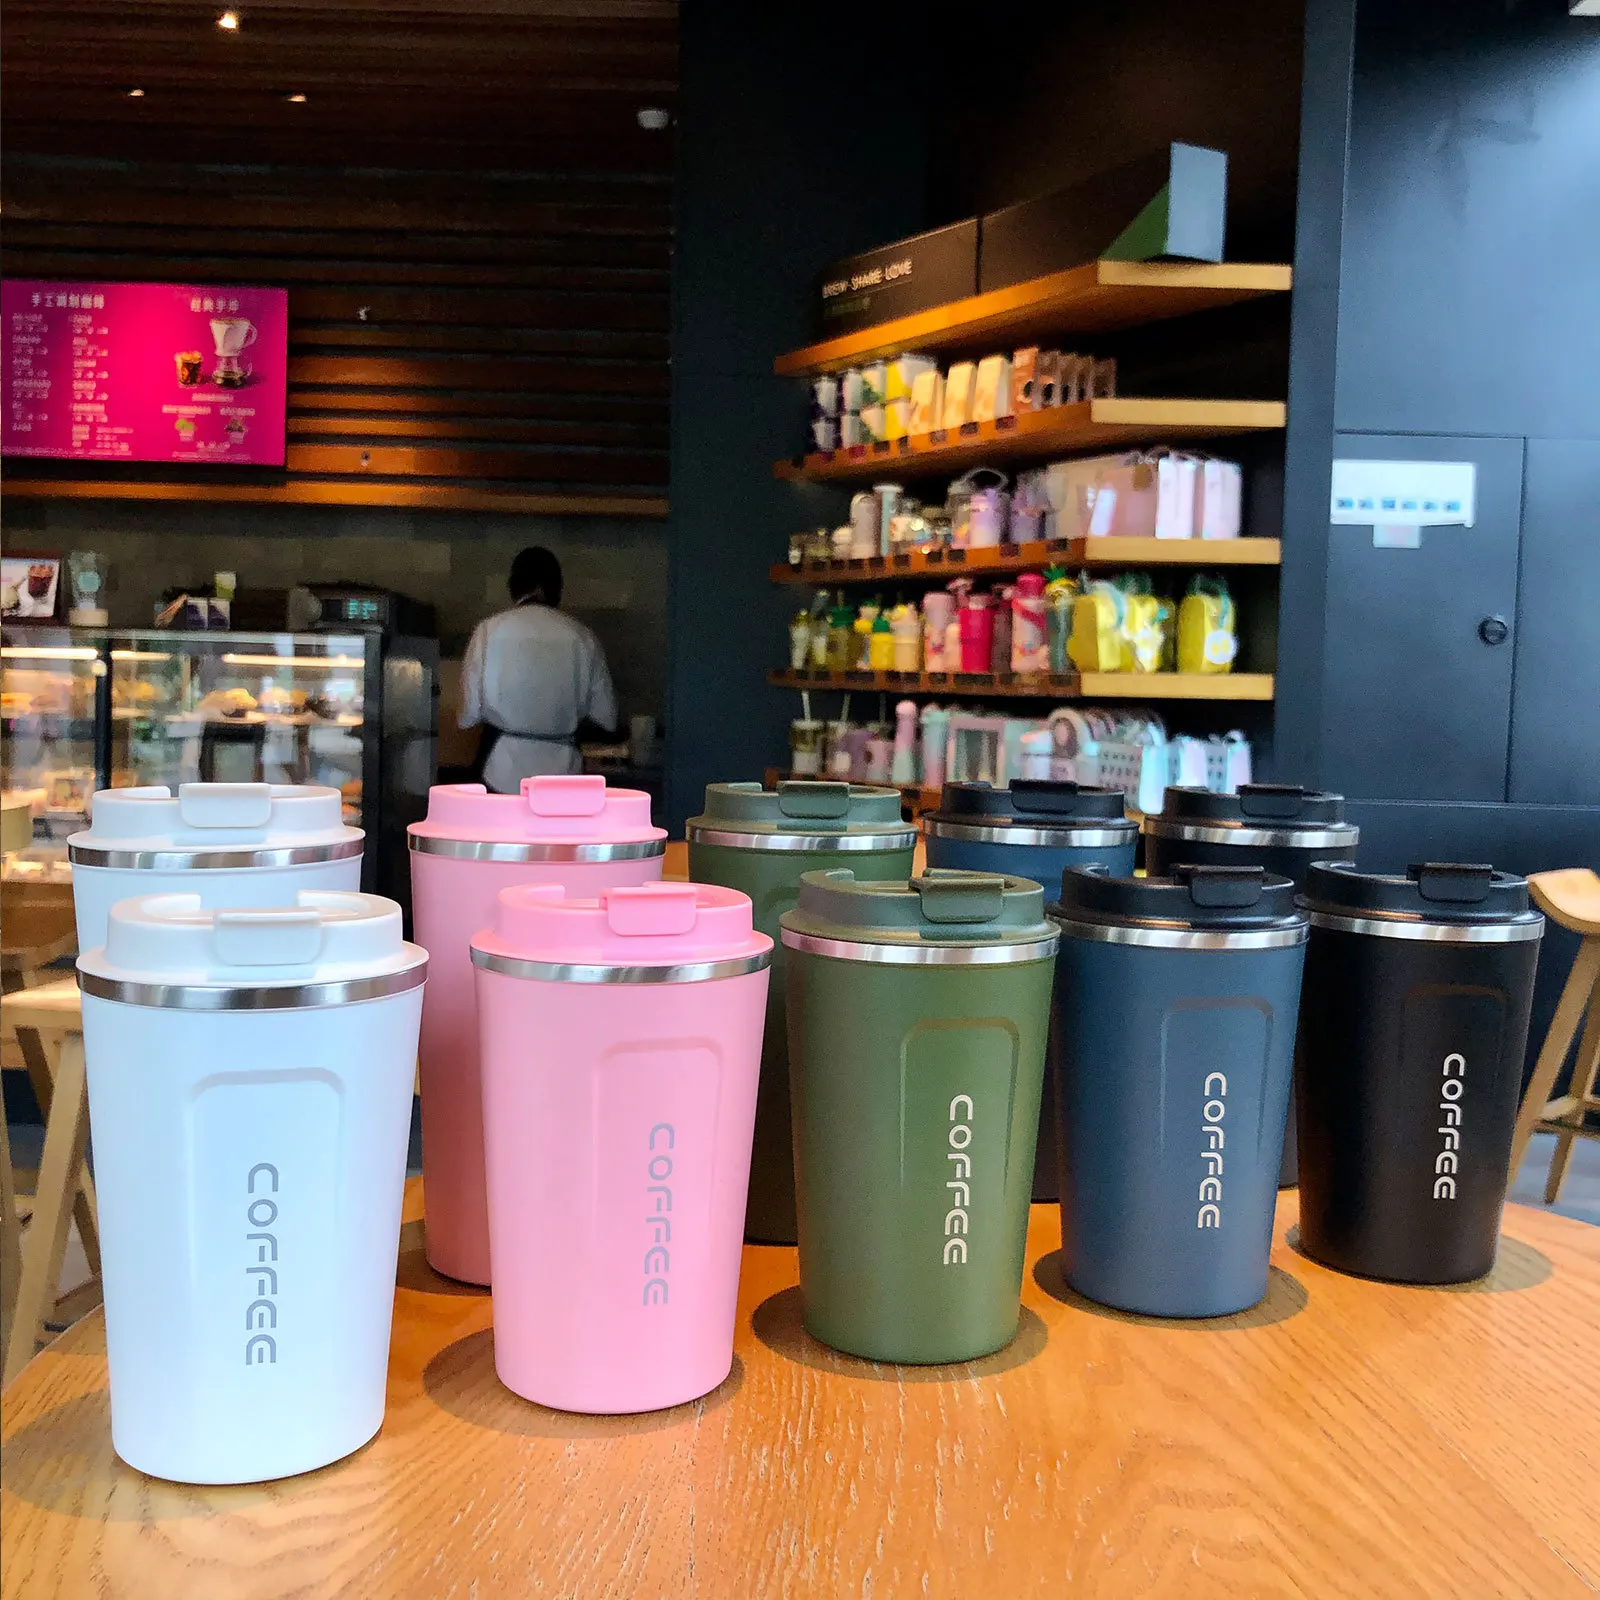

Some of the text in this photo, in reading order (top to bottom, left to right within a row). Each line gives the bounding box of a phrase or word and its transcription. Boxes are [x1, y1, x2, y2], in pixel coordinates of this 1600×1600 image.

[943, 1094, 974, 1265] COFFEE
[1197, 1071, 1227, 1229] COFFEE
[1433, 1053, 1466, 1200] COFFEE
[246, 1162, 279, 1366] COFFEE
[643, 1122, 675, 1306] COFFEE
